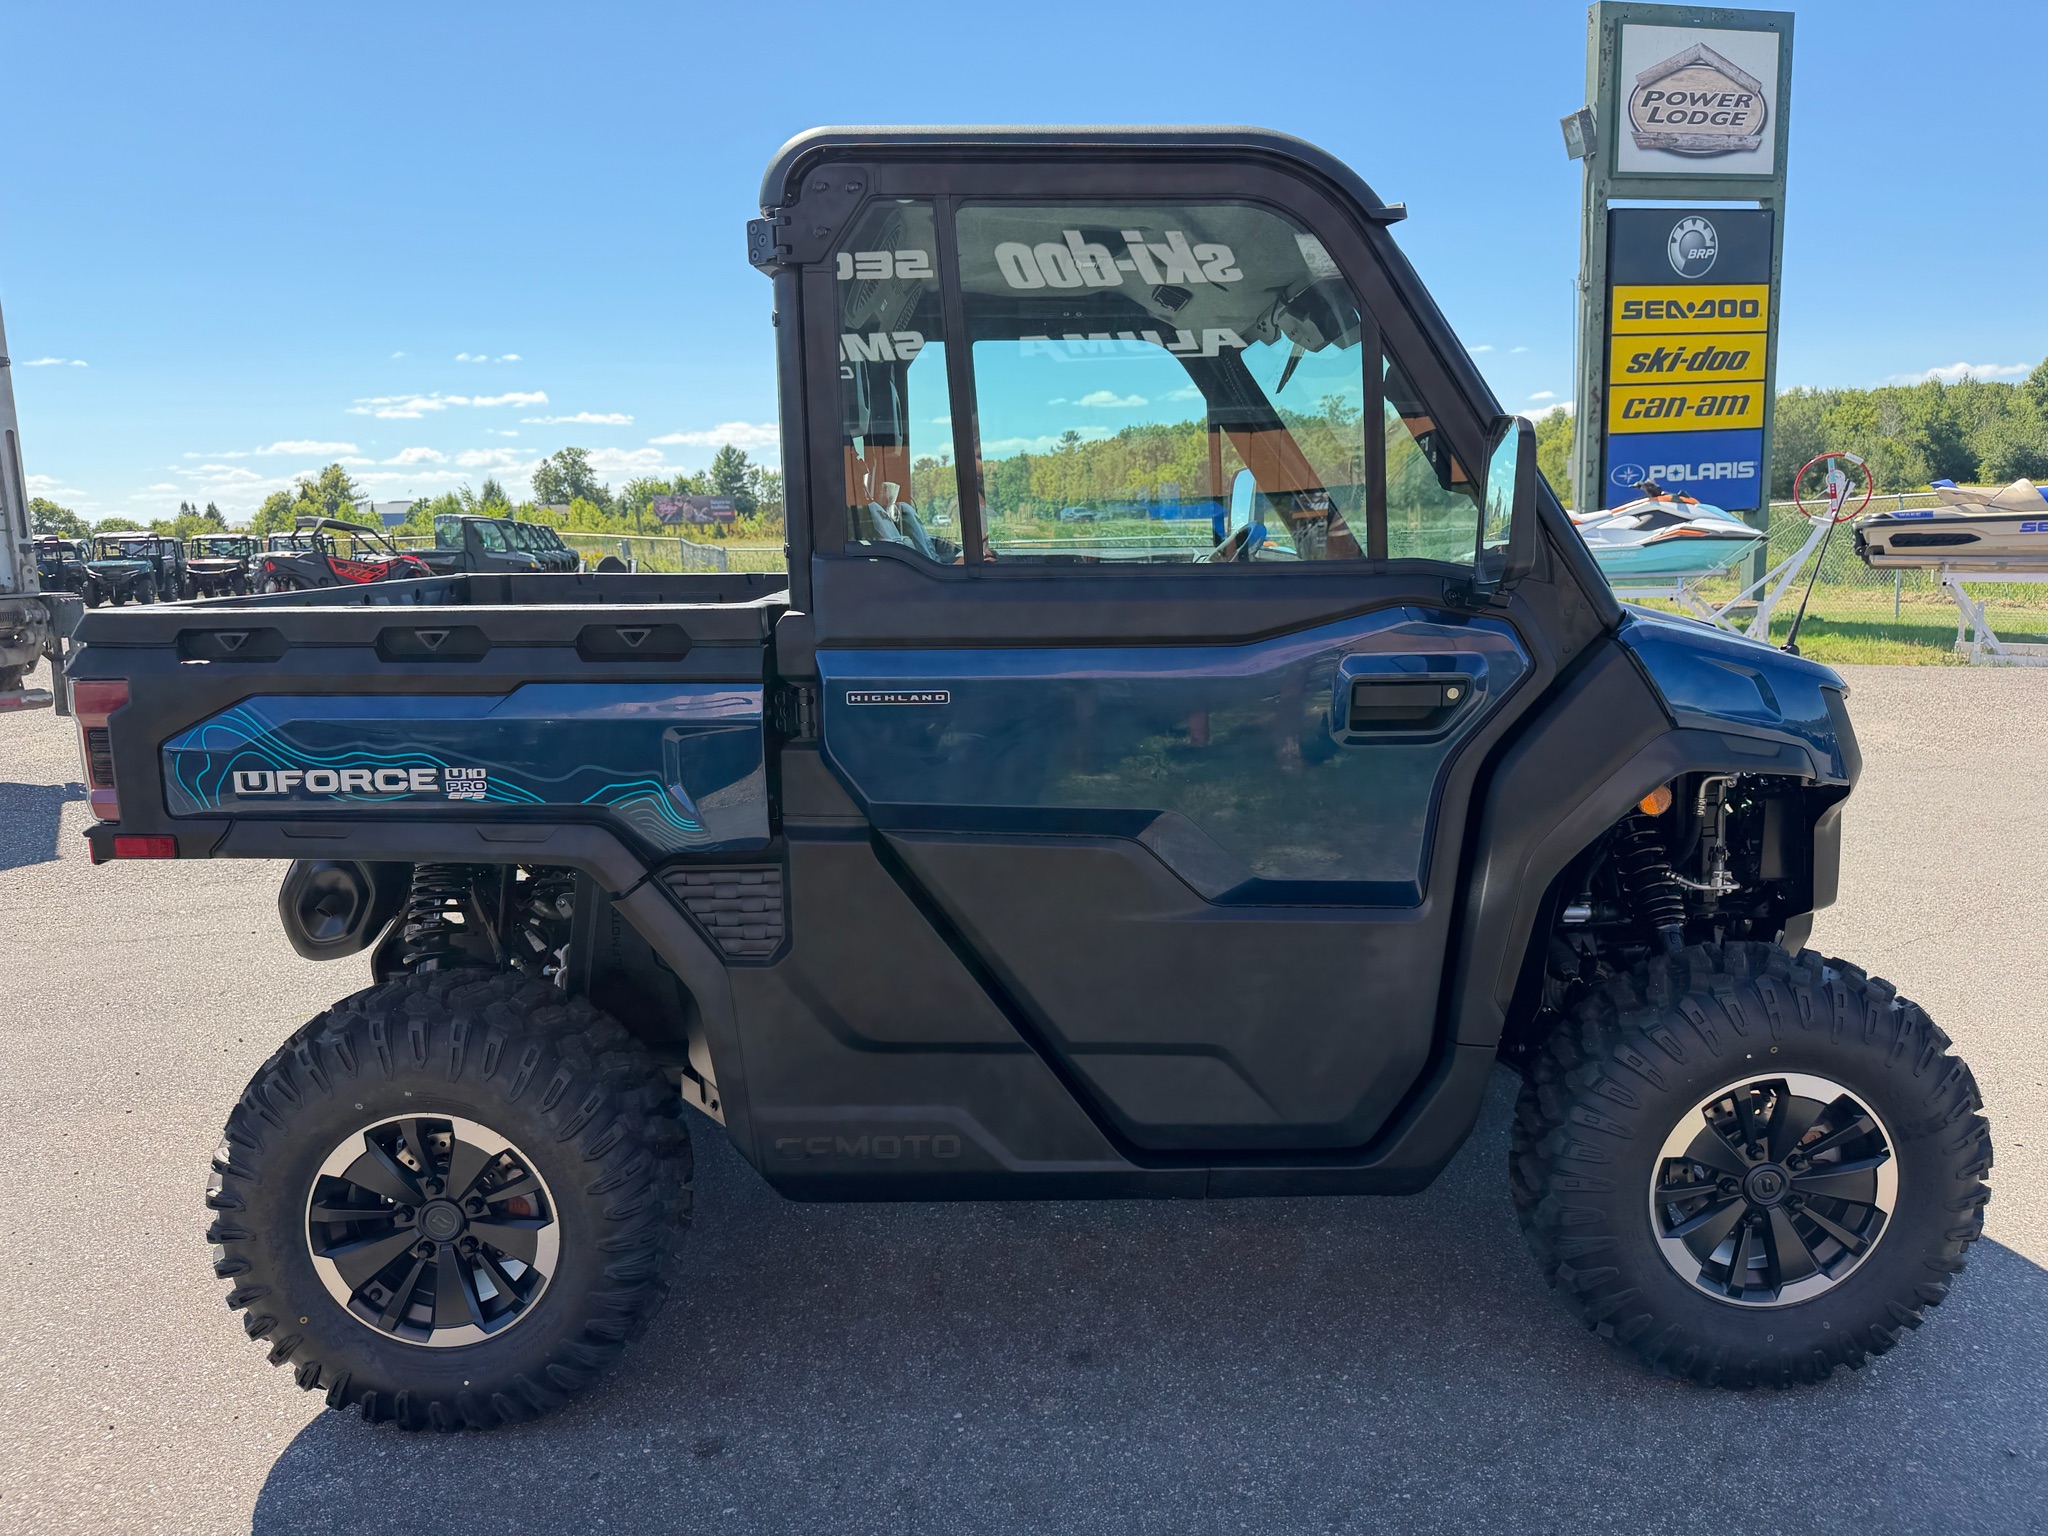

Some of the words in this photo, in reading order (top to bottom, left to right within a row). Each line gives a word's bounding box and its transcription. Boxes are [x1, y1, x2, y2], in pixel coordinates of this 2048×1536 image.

[1640, 91, 1753, 109] POWER
[1646, 107, 1748, 126] LODGE
[1687, 249, 1715, 259] BRP
[1625, 346, 1750, 374] ski-doo
[1622, 394, 1750, 419] can-am
[1649, 460, 1755, 482] POLARIS
[850, 694, 946, 702] HIGHLAND
[233, 768, 440, 794] UFORCE
[445, 768, 486, 779] U10
[446, 781, 487, 792] PRO
[775, 1135, 961, 1161] CFMOTO
